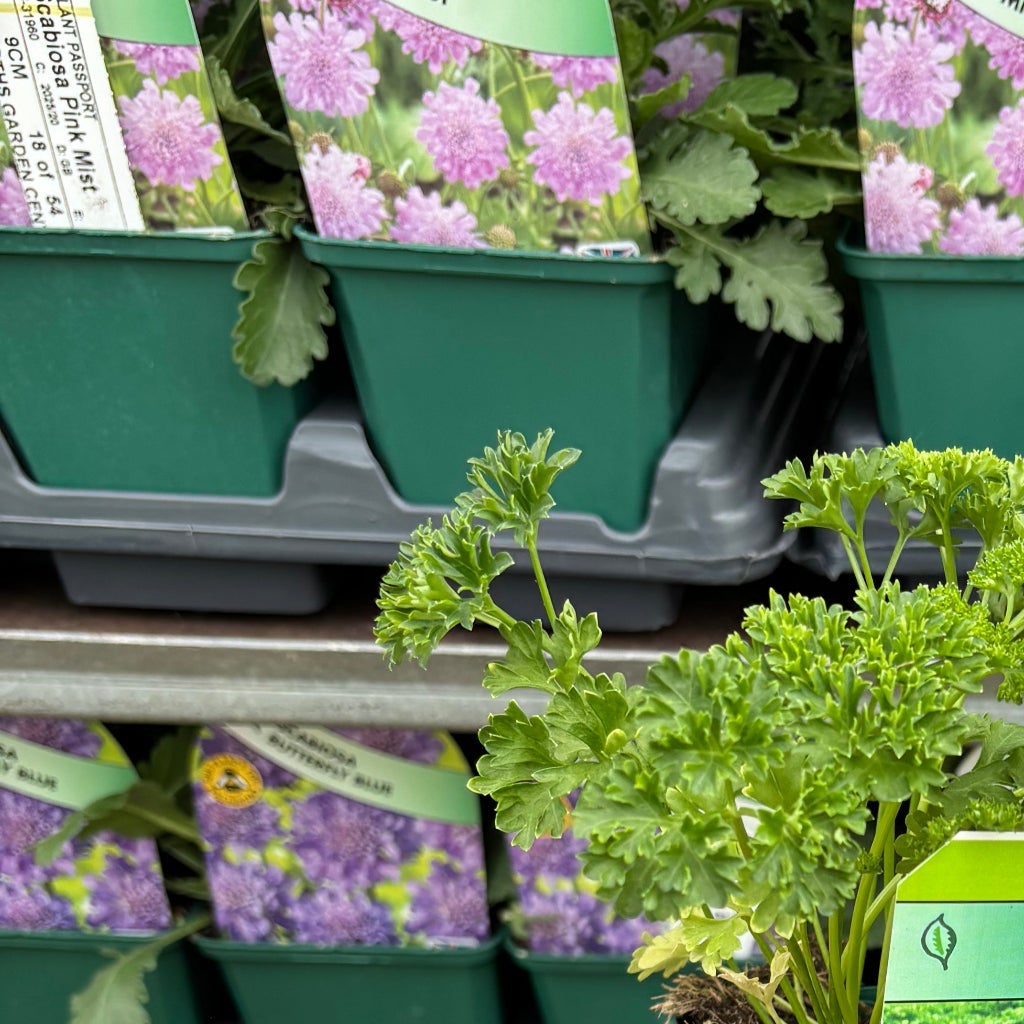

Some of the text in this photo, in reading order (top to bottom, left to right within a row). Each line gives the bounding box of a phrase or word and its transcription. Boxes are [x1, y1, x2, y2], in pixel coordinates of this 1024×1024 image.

[4, 37, 29, 80] 9CM
[28, 131, 46, 151] 18
[37, 161, 55, 179] of
[36, 0, 98, 193] cabiosa Pink Mist
[56, 0, 97, 120] LANT PASSPORT
[2, 104, 34, 182] GARDEN
